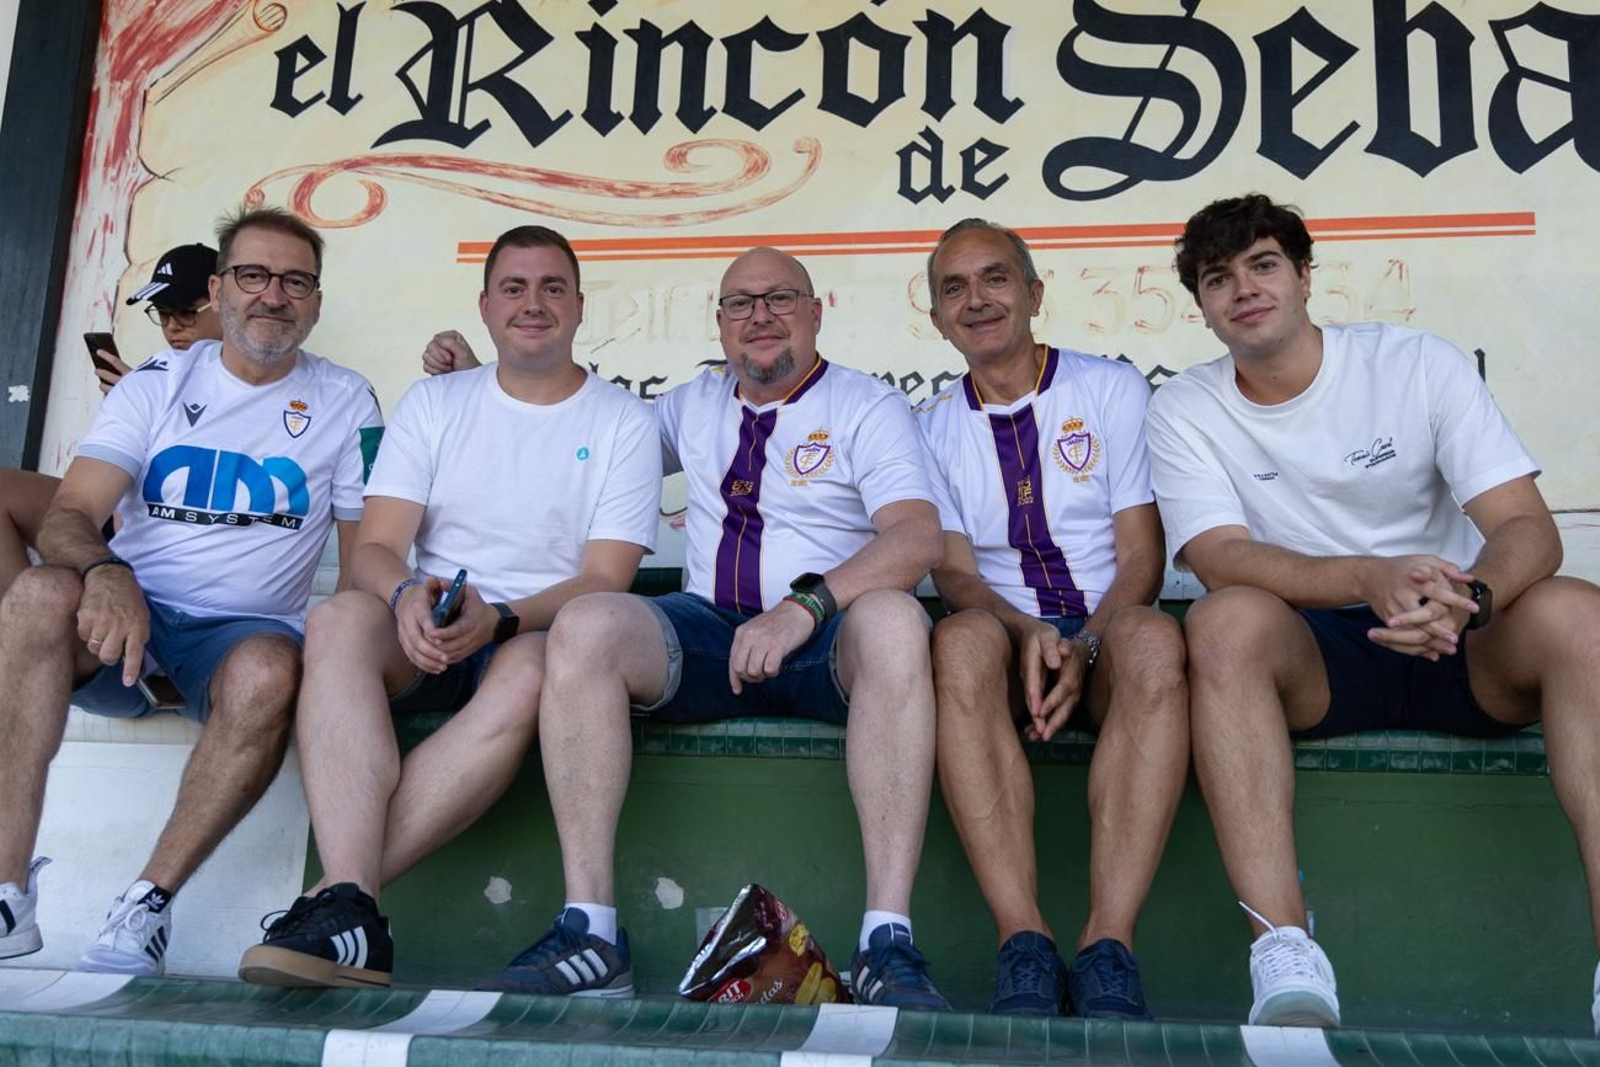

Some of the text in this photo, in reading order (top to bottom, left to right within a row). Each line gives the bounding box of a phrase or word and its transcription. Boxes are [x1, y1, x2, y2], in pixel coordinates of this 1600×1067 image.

[270, 0, 1025, 149] el Rincón
[896, 126, 1009, 205] de
